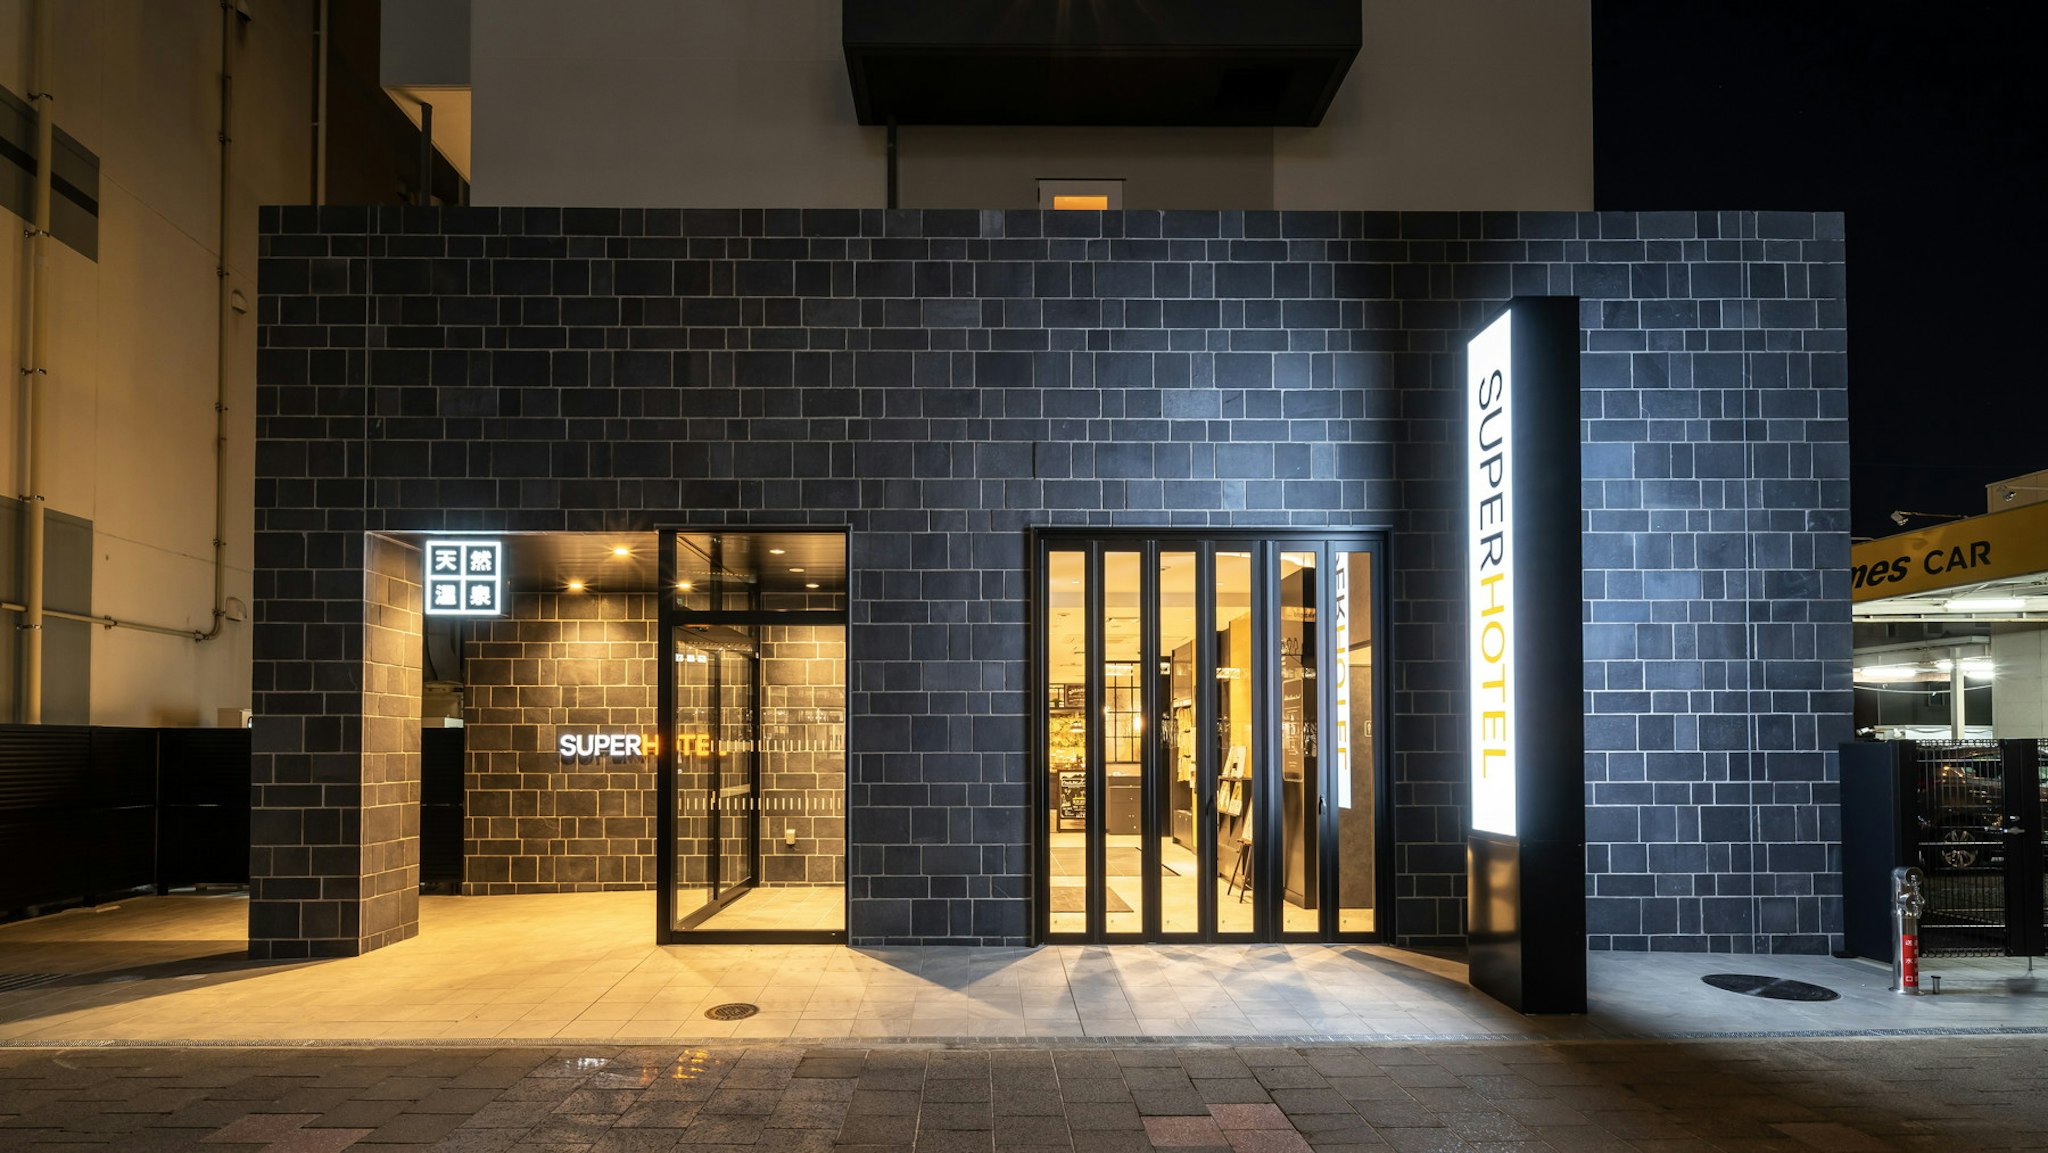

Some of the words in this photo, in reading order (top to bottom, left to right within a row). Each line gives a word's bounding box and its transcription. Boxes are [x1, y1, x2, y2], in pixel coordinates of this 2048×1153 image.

[435, 550, 493, 572] 天然
[1923, 541, 1992, 575] CAR
[560, 733, 728, 757] SUPERHTE
